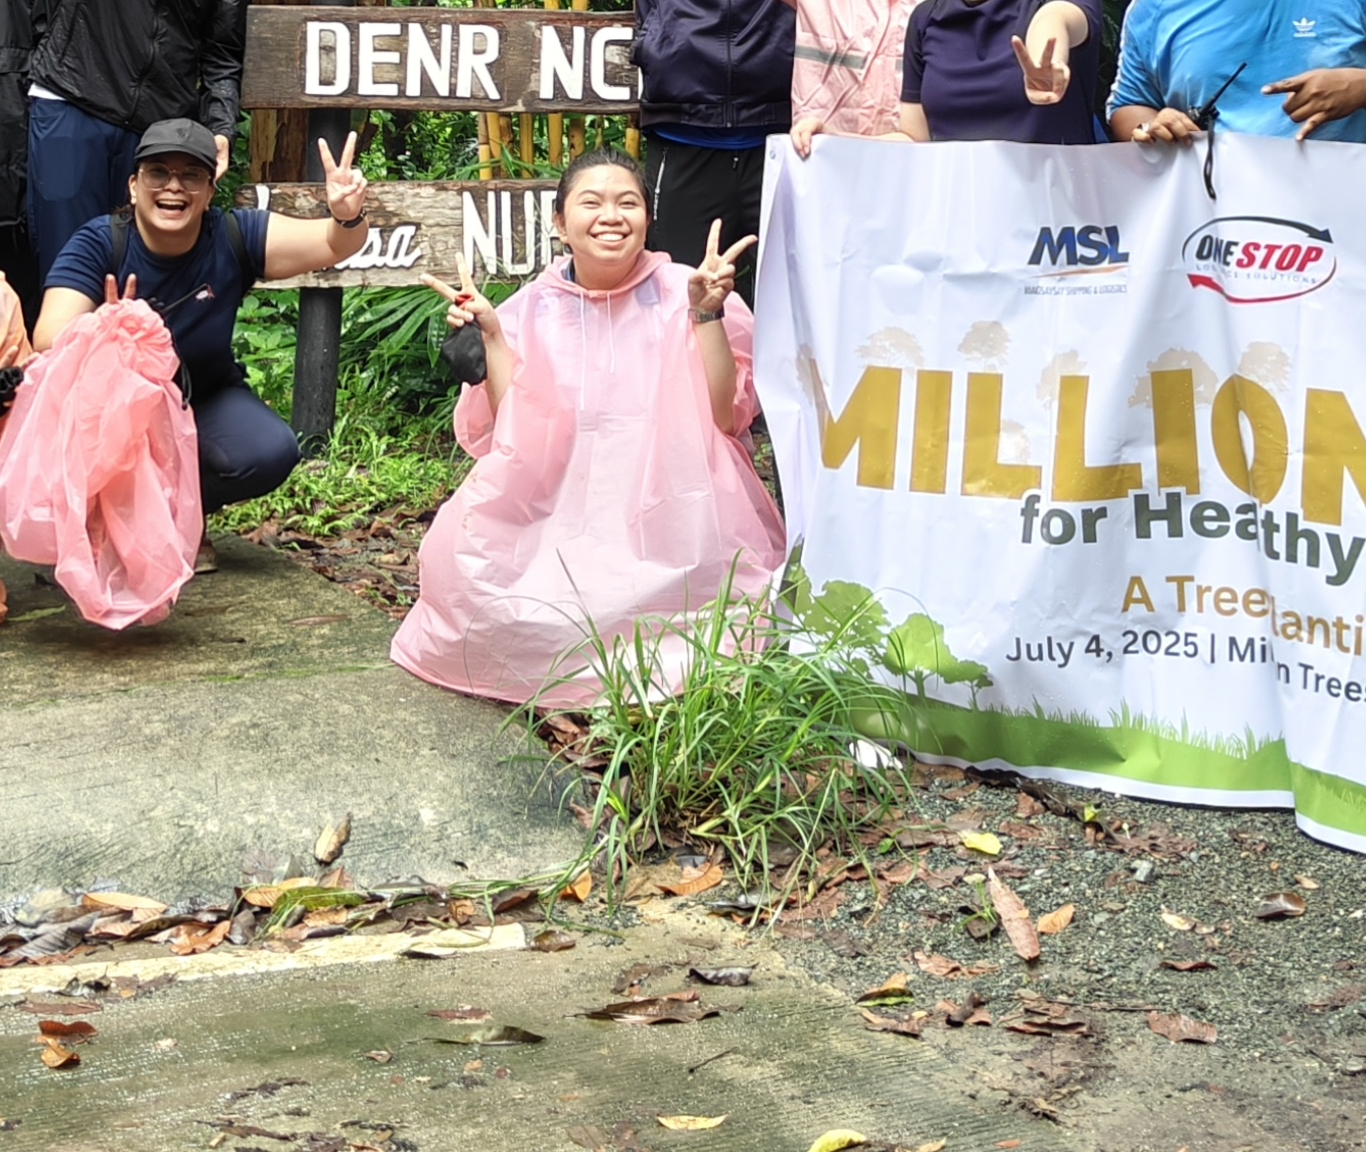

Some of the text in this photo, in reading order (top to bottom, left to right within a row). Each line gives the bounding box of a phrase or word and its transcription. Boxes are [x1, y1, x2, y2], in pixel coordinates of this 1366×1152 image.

[304, 20, 644, 100] DENR NC
[1028, 225, 1131, 267] MSL
[1020, 494, 1108, 546] for
[1121, 575, 1156, 613] A
[1005, 636, 1075, 669] July
[1084, 634, 1114, 663] 4,
[1121, 629, 1200, 659] 2025
